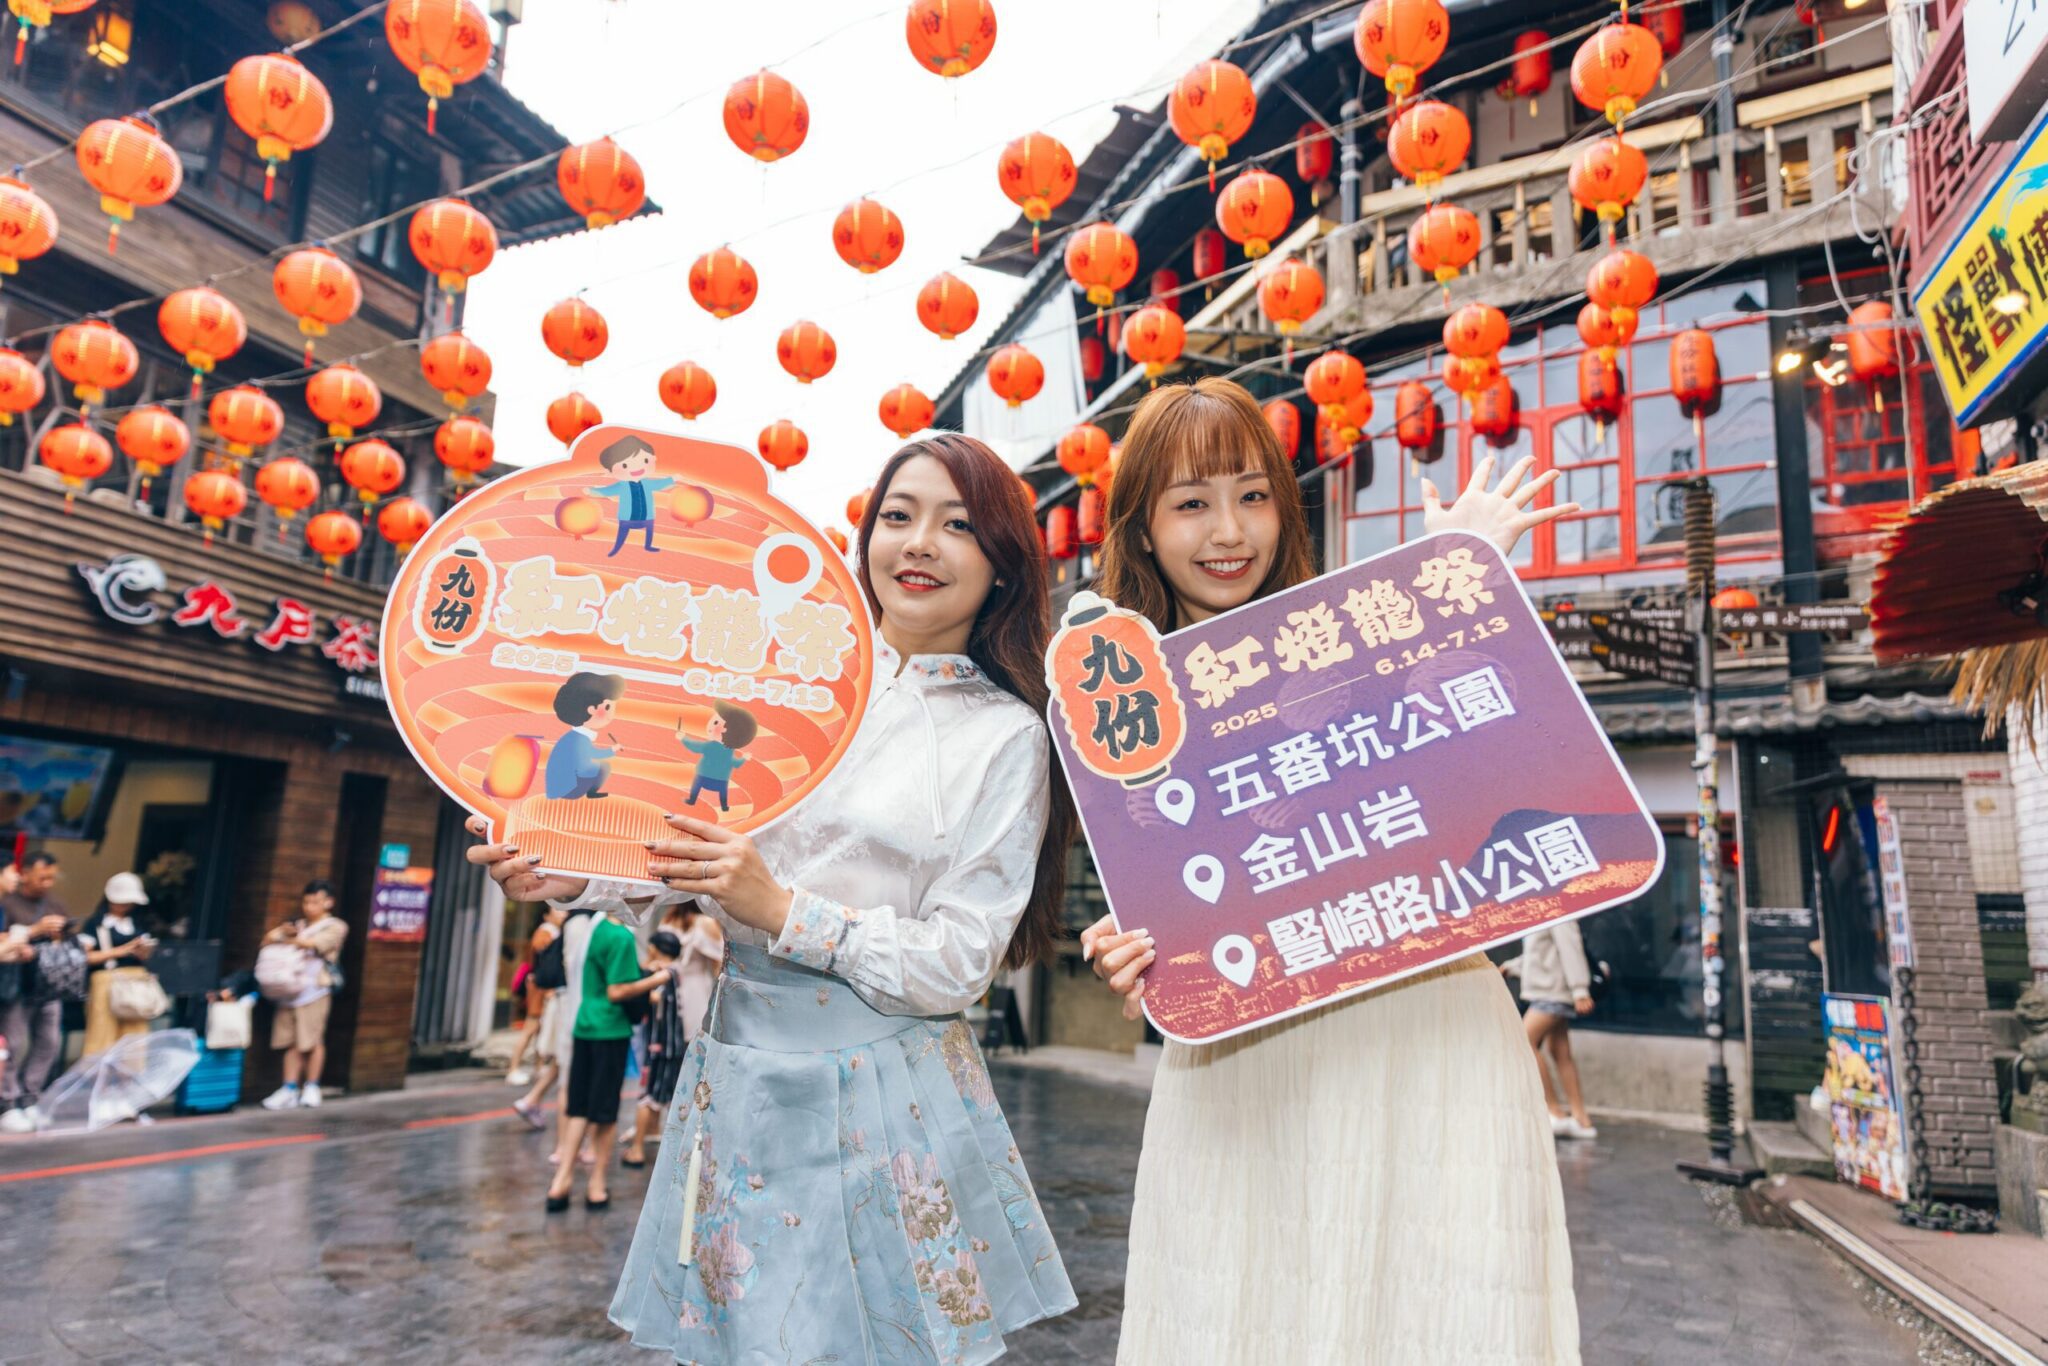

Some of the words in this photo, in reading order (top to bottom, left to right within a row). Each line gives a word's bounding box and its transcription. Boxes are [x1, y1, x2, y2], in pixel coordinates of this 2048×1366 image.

[431, 563, 476, 633] 九份
[497, 559, 856, 679] 紅燈籠祭
[1184, 547, 1496, 709] 紅燈籠祭
[494, 645, 575, 673] 2025
[685, 670, 832, 708] 6.14-7.13
[1077, 633, 1161, 761] 九份
[1211, 702, 1279, 739] 2025
[1374, 615, 1511, 677] 6.14-7.13
[1207, 665, 1517, 817] 五番坑公園
[1239, 784, 1429, 895] 金山岩
[1265, 815, 1601, 978] 豎崎路小公園
